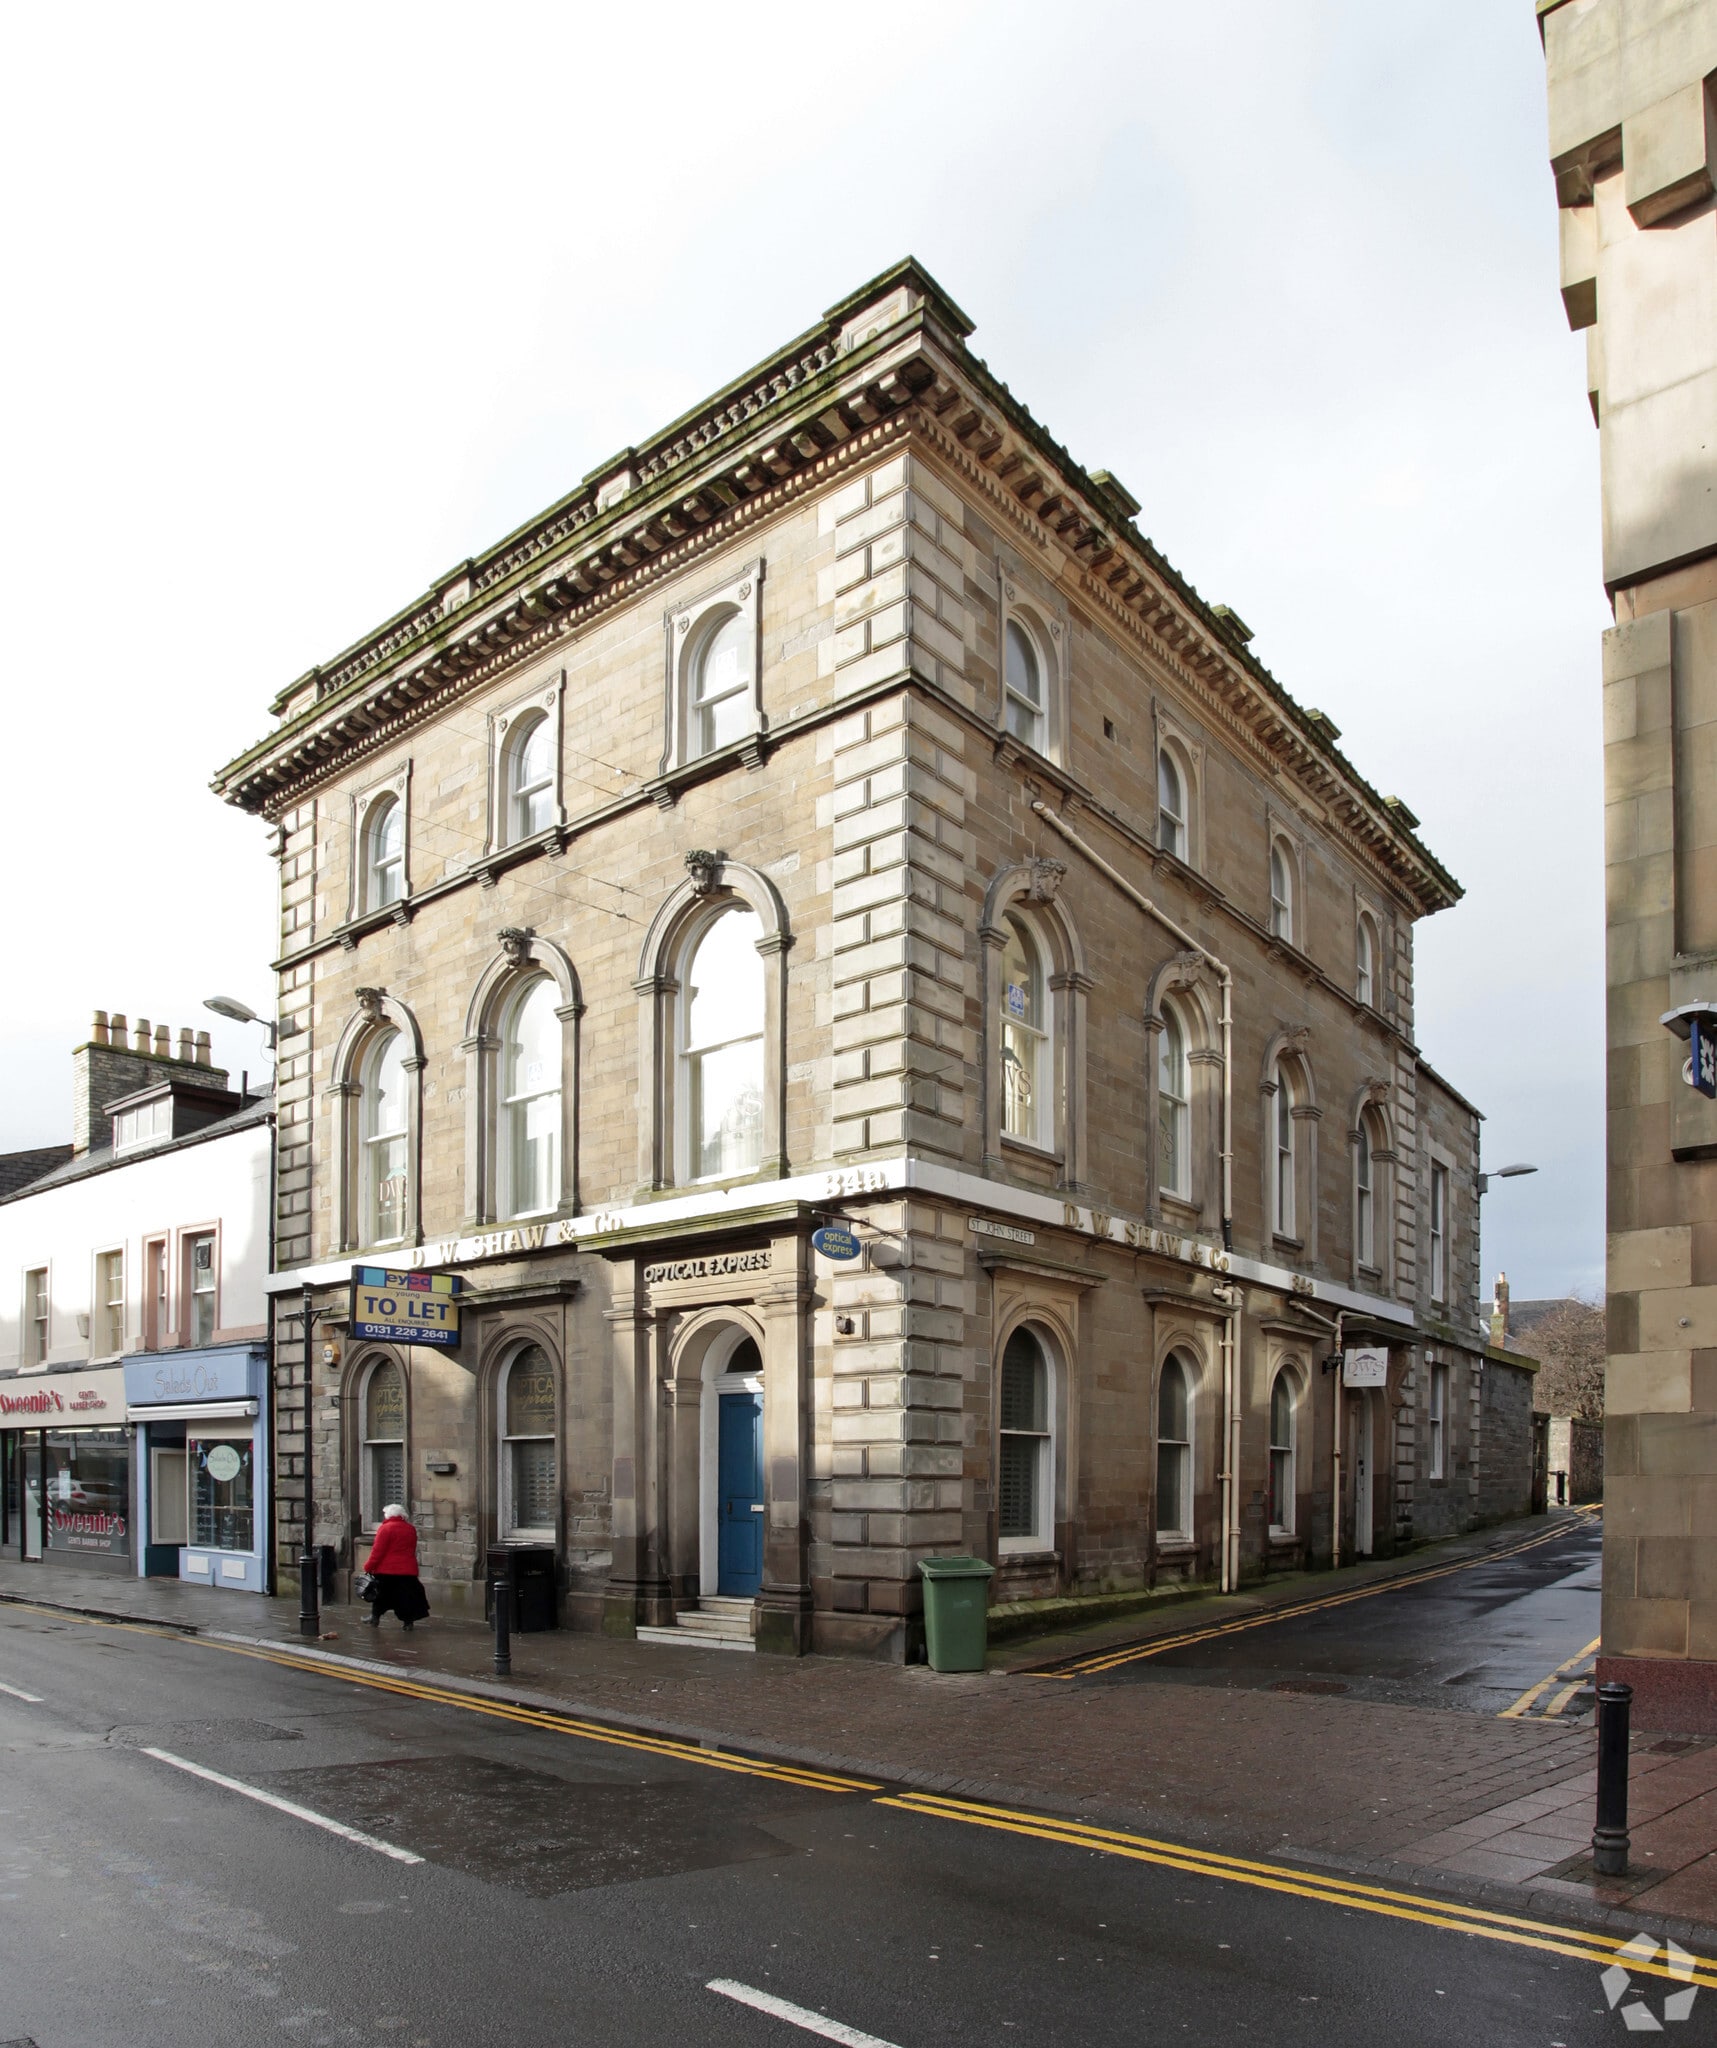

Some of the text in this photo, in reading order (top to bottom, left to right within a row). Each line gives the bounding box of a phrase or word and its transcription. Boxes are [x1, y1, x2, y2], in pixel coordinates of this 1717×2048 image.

[472, 1224, 548, 1258] SHAW
[558, 1219, 577, 1242] &
[824, 1231, 852, 1245] optical
[971, 1219, 1032, 1243] ST JOHN STREET
[1063, 1203, 1230, 1272] D. W. SHAW & Co
[822, 1241, 853, 1256] express
[643, 1252, 772, 1284] OPTICAL EXPRESS
[387, 1273, 430, 1288] eyco
[364, 1296, 450, 1321] TO LET
[364, 1324, 391, 1334] 0131
[395, 1326, 418, 1337] 226
[422, 1329, 448, 1340] 2641
[398, 1319, 430, 1327] ENQUIRIES
[153, 1364, 219, 1399] Salads Out
[0, 1390, 64, 1415] Sweenie's
[55, 1509, 126, 1537] Sweenie's
[67, 1536, 112, 1548] GENTS BARBER SHOP
